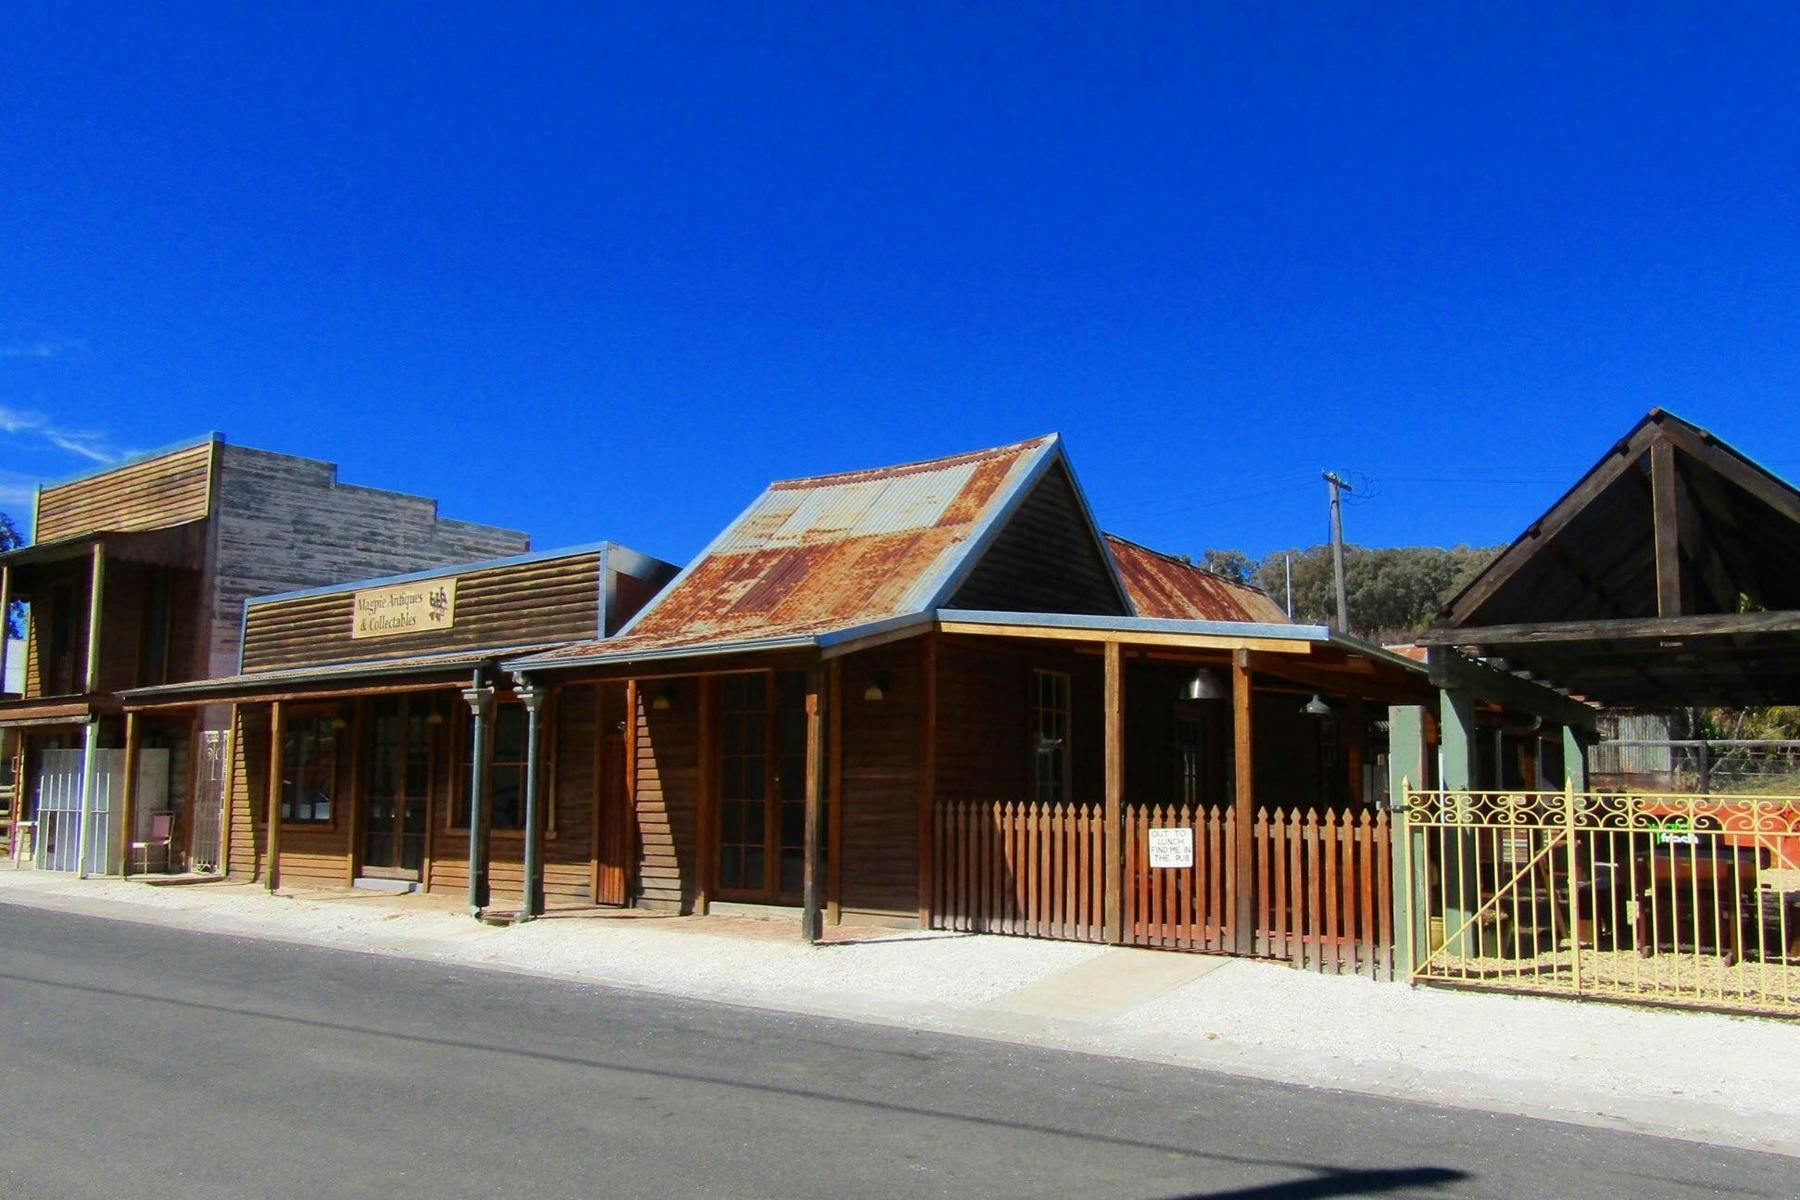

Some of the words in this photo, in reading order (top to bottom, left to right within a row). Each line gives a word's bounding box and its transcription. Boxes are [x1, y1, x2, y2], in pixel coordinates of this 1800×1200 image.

[358, 595, 387, 615] Magpie
[389, 593, 423, 610] Antiques
[360, 618, 367, 631] &
[369, 612, 417, 631] Collectables
[1157, 838, 1184, 846] LUNCH
[1151, 846, 1168, 854] FIND
[1169, 846, 1183, 854] ME
[1183, 846, 1192, 854] IN
[1154, 854, 1169, 862] THE
[1175, 854, 1190, 862] PUB
